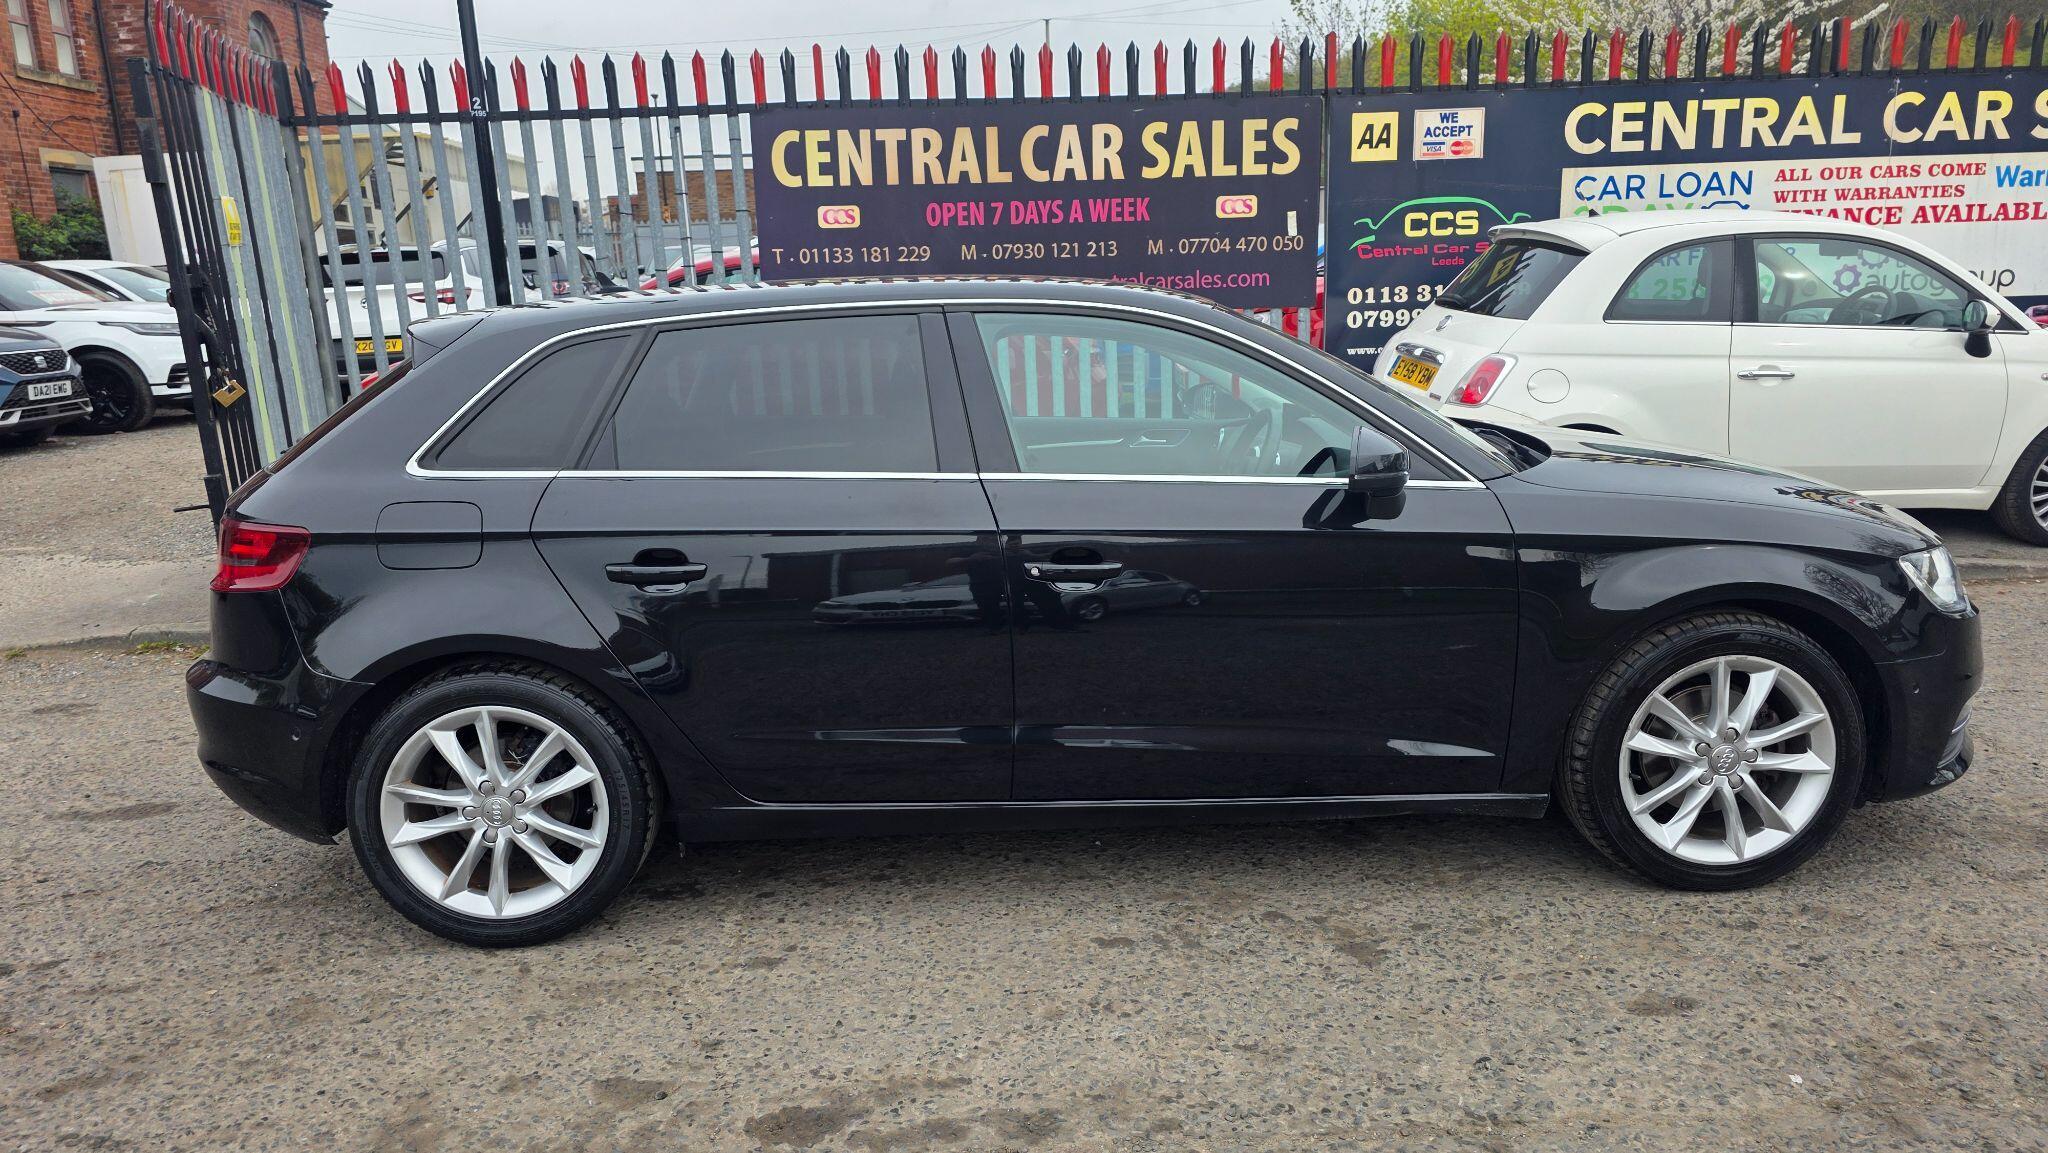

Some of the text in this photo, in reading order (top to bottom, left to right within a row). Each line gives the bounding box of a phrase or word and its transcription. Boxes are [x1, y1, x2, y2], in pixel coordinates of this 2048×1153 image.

[472, 96, 481, 109] 2
[1439, 112, 1459, 124] WE
[1564, 95, 1862, 155] CENTRAL
[1883, 90, 2014, 144] CAR
[1356, 122, 1391, 149] AA
[1424, 125, 1473, 138] ACCEPT
[771, 117, 1301, 188] CENTRAL CAR SALES
[1774, 162, 1987, 182] ALL OUR CARS COME
[1995, 164, 2048, 188] War
[1574, 169, 1754, 201] CAR LOAN
[1773, 184, 1966, 204] WITH WARRANTIES
[822, 208, 856, 225] CCS
[926, 197, 1151, 227] OPEN 7 DAYS A WEEK
[1220, 198, 1253, 216] CCS
[1404, 209, 1480, 238] CCS
[991, 242, 1045, 259] 07930
[1052, 242, 1079, 258] 121
[1087, 240, 1118, 257] 213
[1178, 237, 1231, 254] 07704
[1235, 236, 1267, 252] 470
[1272, 235, 1304, 251] 050
[1357, 243, 1428, 260] Central
[1433, 243, 1470, 254] Car
[799, 247, 854, 264] 01133
[861, 246, 890, 263] 181
[898, 245, 931, 262] 229
[1431, 256, 1465, 266] Leeds
[1347, 285, 1409, 305] 0113
[1393, 359, 1419, 379] EY58
[33, 384, 52, 397] DA21
